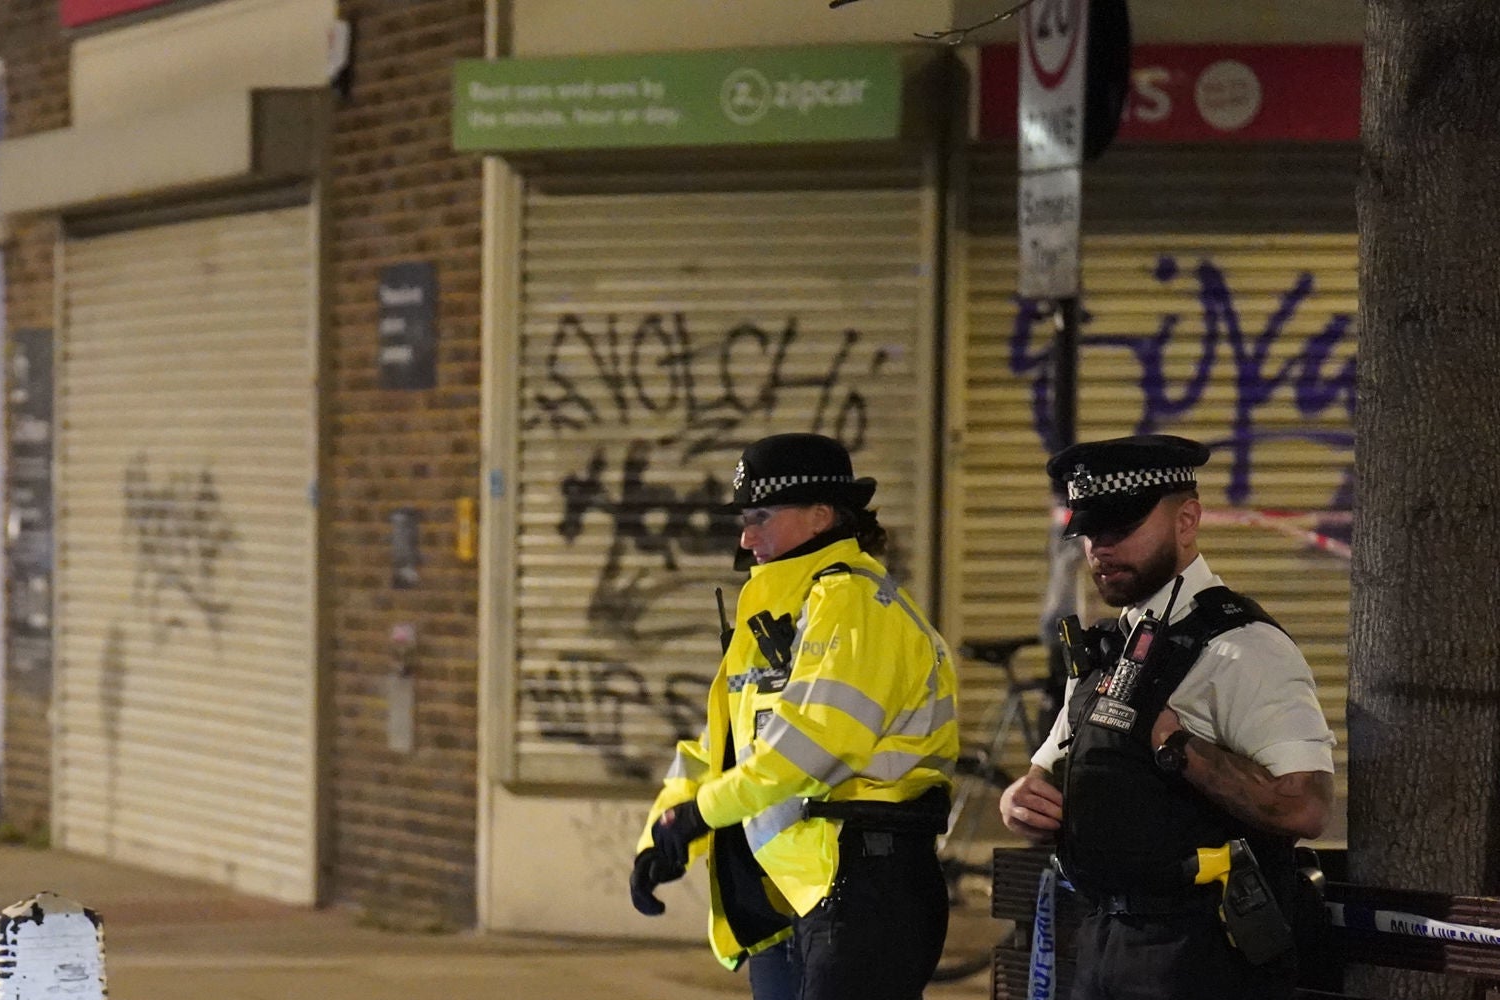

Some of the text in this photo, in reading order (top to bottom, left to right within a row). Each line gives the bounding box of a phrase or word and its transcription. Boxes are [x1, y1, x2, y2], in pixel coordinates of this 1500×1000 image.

[1108, 707, 1129, 718] POLICE
[1090, 712, 1132, 730] POLICE OFFICER
